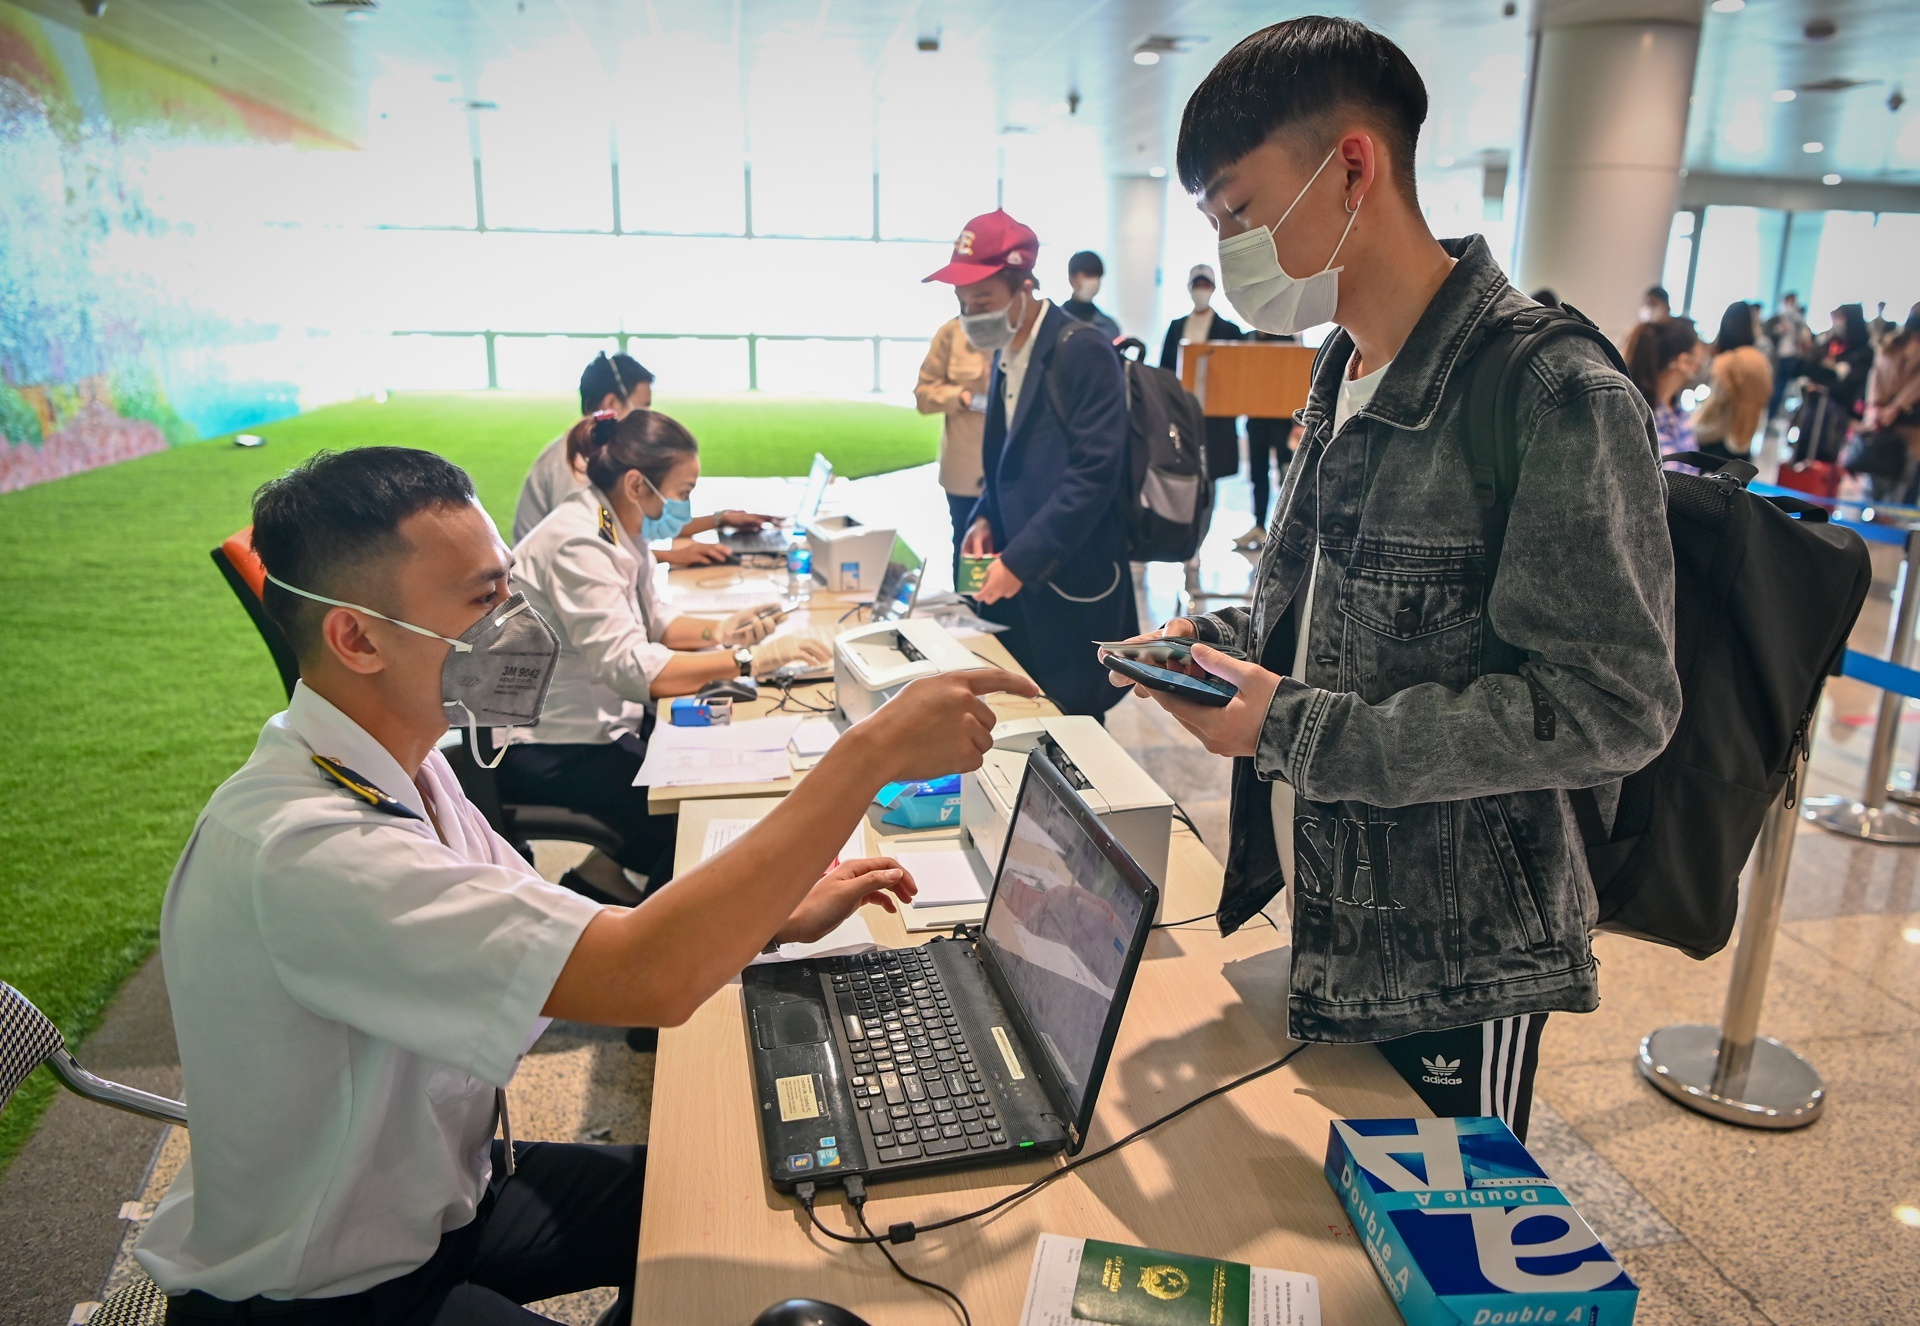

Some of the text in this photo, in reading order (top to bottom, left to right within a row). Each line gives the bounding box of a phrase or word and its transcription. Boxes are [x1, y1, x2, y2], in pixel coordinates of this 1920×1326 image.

[502, 666, 540, 678] 3M 9042
[1422, 1074, 1462, 1085] adidas
[1415, 1189, 1539, 1206] Double A
[1341, 1166, 1409, 1293] Double A
[1473, 1306, 1582, 1325] Double A
